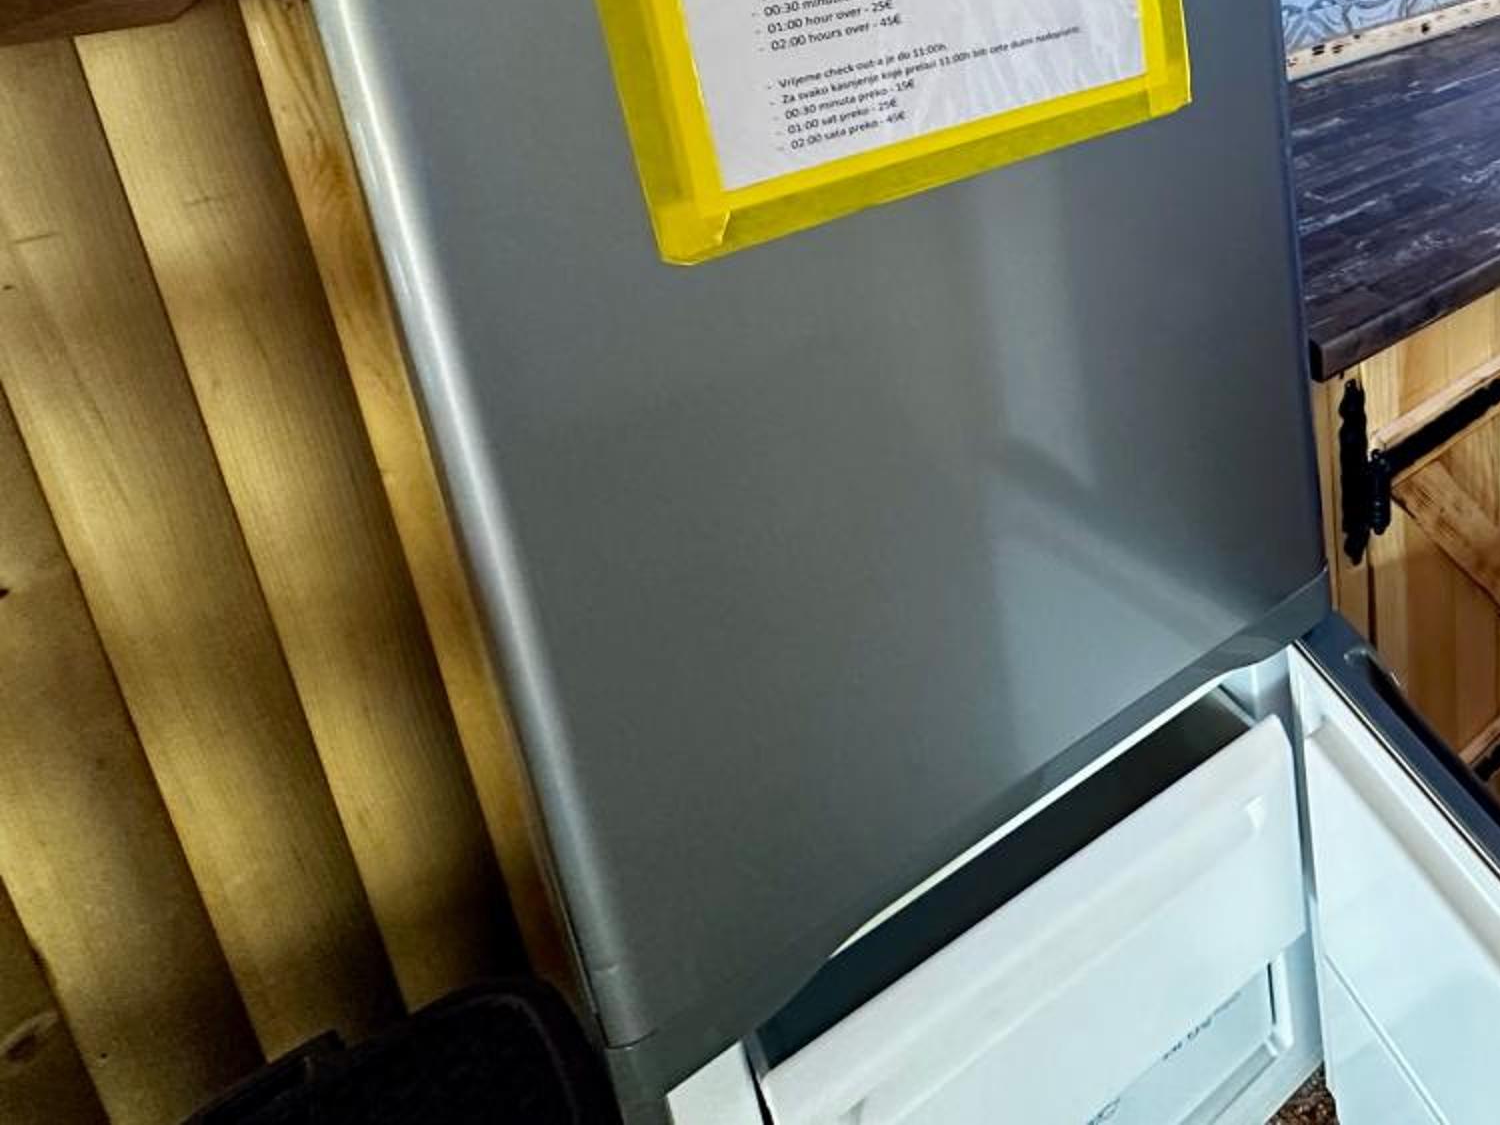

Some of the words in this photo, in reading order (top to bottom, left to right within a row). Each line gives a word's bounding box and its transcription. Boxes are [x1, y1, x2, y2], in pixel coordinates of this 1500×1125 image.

[805, 12, 834, 26] hour
[835, 7, 862, 21] over
[808, 29, 843, 44] hours
[845, 22, 870, 36] over
[879, 13, 902, 27] 45€
[778, 72, 822, 89] Vrijeme
[823, 64, 855, 79] check
[782, 93, 796, 105] Za
[797, 85, 829, 100] svako
[818, 94, 857, 111] minuta
[858, 87, 889, 103] preko
[895, 78, 915, 92] 15€
[821, 113, 838, 126] sat
[839, 107, 870, 122] preko
[823, 127, 847, 141] sata
[848, 120, 879, 136] preko
